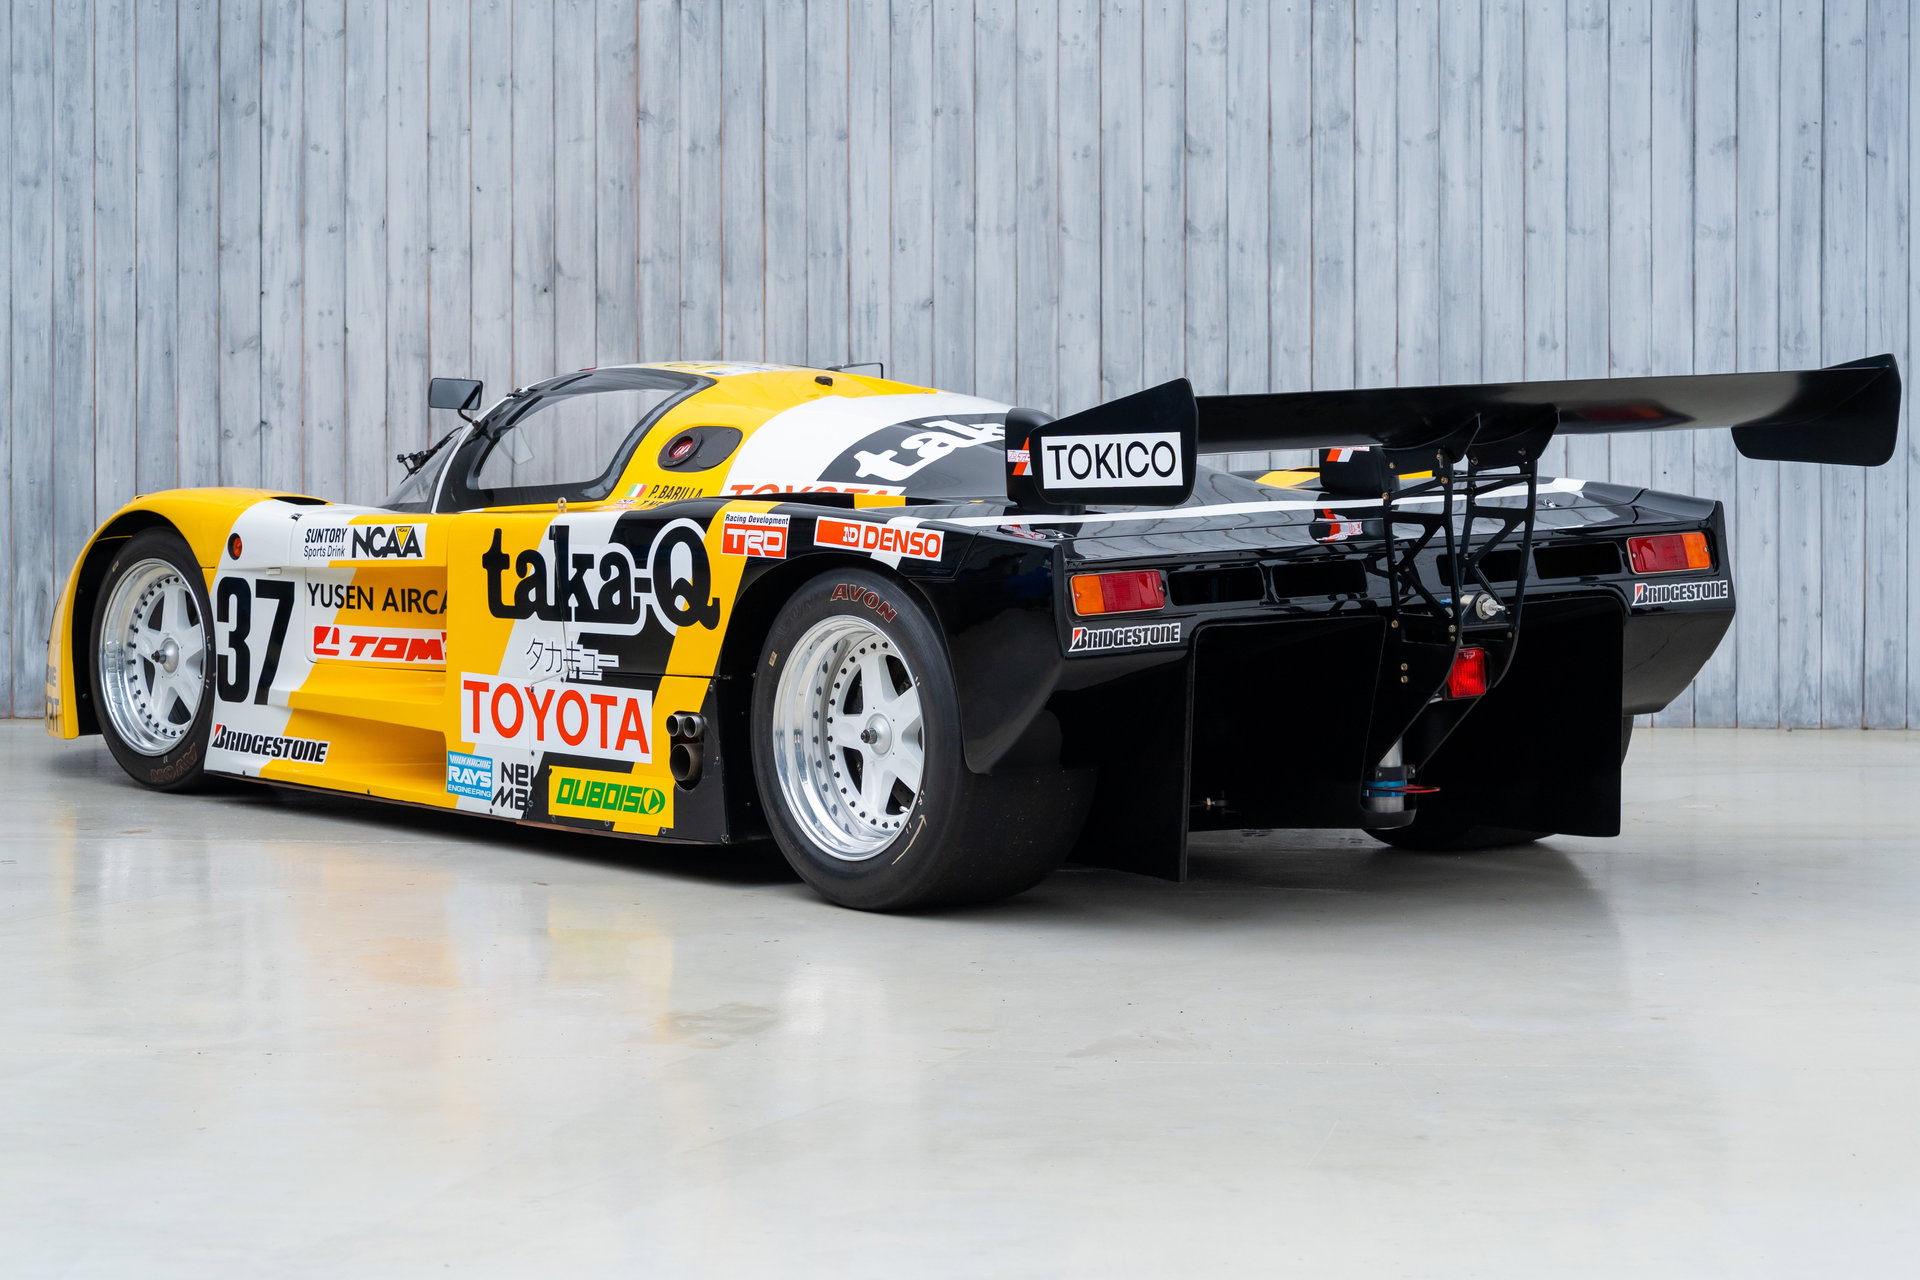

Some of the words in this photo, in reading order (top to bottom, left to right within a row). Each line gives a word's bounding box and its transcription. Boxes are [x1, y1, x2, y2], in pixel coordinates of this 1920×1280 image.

[854, 419, 1005, 482] tak
[1046, 440, 1177, 480] TOKICO
[305, 527, 348, 544] SUNTORY
[725, 513, 747, 524] Racing
[748, 515, 789, 526] Development
[304, 545, 326, 560] Sports
[327, 545, 346, 557] Drink
[352, 526, 423, 559] NCAA
[726, 528, 783, 557] TRD
[863, 525, 941, 559] DENSO
[482, 525, 721, 630] taka-Q
[1632, 580, 1729, 606] BRIDGESTONE
[307, 583, 374, 611] YUSEN
[831, 583, 898, 624] AVON
[217, 576, 296, 706] 37
[1069, 622, 1181, 652] BRIDGESTONE
[526, 638, 616, 678] タカキュー
[463, 680, 650, 754] TOYOTA
[211, 723, 329, 763] BRIDGESTONE
[448, 765, 492, 788] RAYS
[448, 784, 492, 798] ENGINEERING
